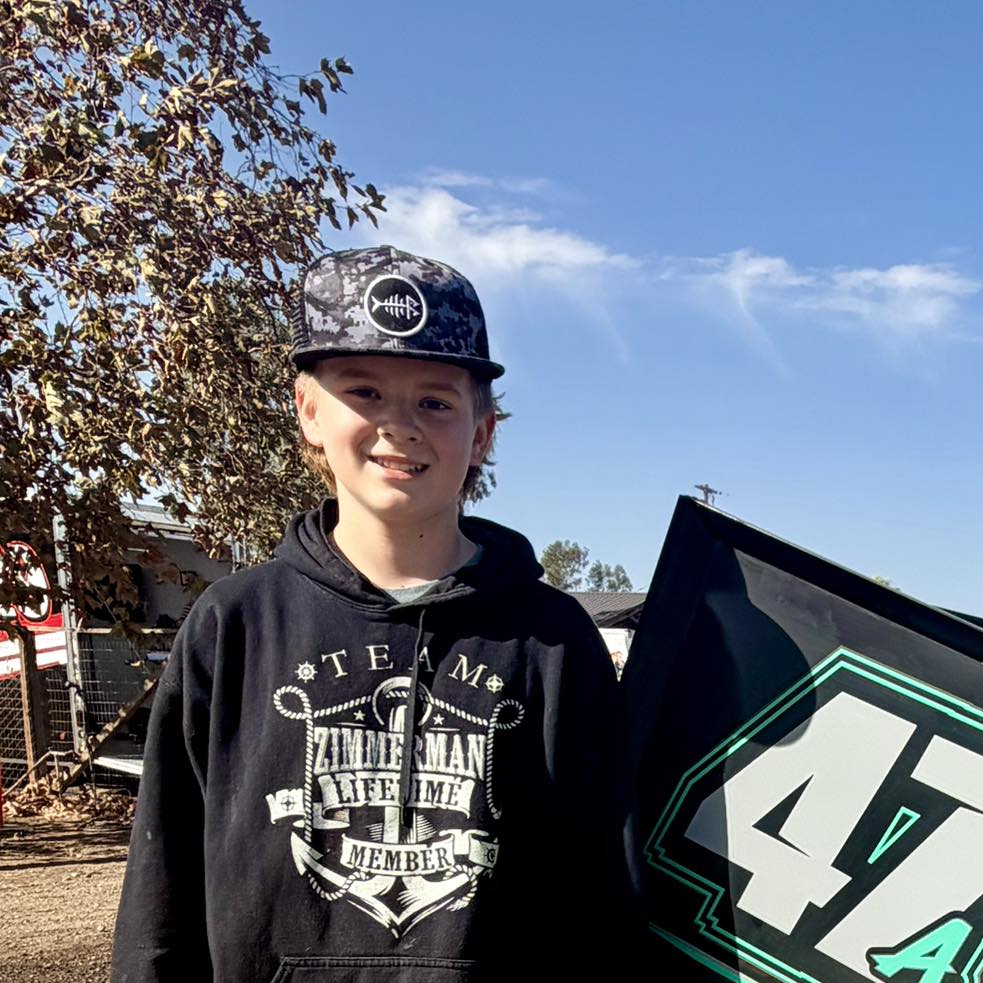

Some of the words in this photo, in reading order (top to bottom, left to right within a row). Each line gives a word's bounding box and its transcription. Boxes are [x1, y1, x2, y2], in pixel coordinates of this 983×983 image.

[322, 644, 488, 688] TEAM
[336, 777, 463, 808] LIFEIME
[347, 843, 452, 872] MEMBER
